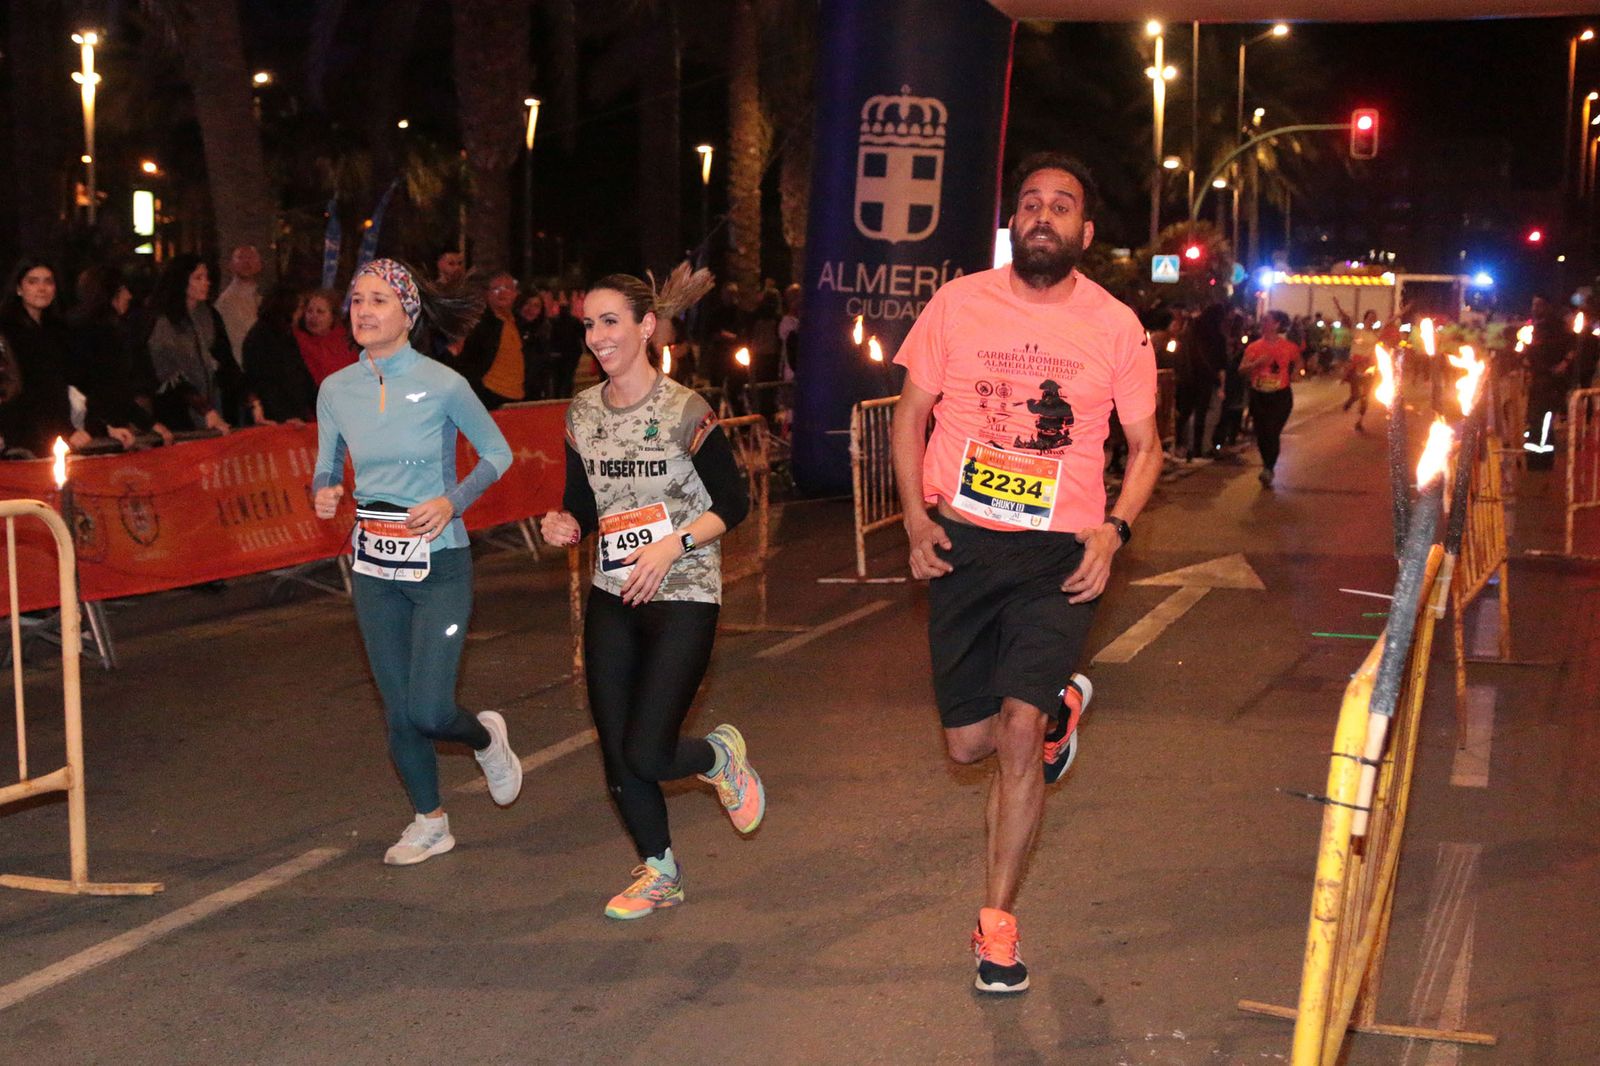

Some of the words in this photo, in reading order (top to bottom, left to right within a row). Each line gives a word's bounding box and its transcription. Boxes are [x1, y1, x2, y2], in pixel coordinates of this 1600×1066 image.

[977, 350, 1025, 362] CARRERA
[1028, 355, 1085, 370] BOMBEROS
[1036, 365, 1078, 375] CIUDAD
[980, 469, 1043, 499] 2234
[991, 498, 1016, 511] CHUKY
[374, 538, 410, 556] 497
[616, 528, 653, 551] 499
